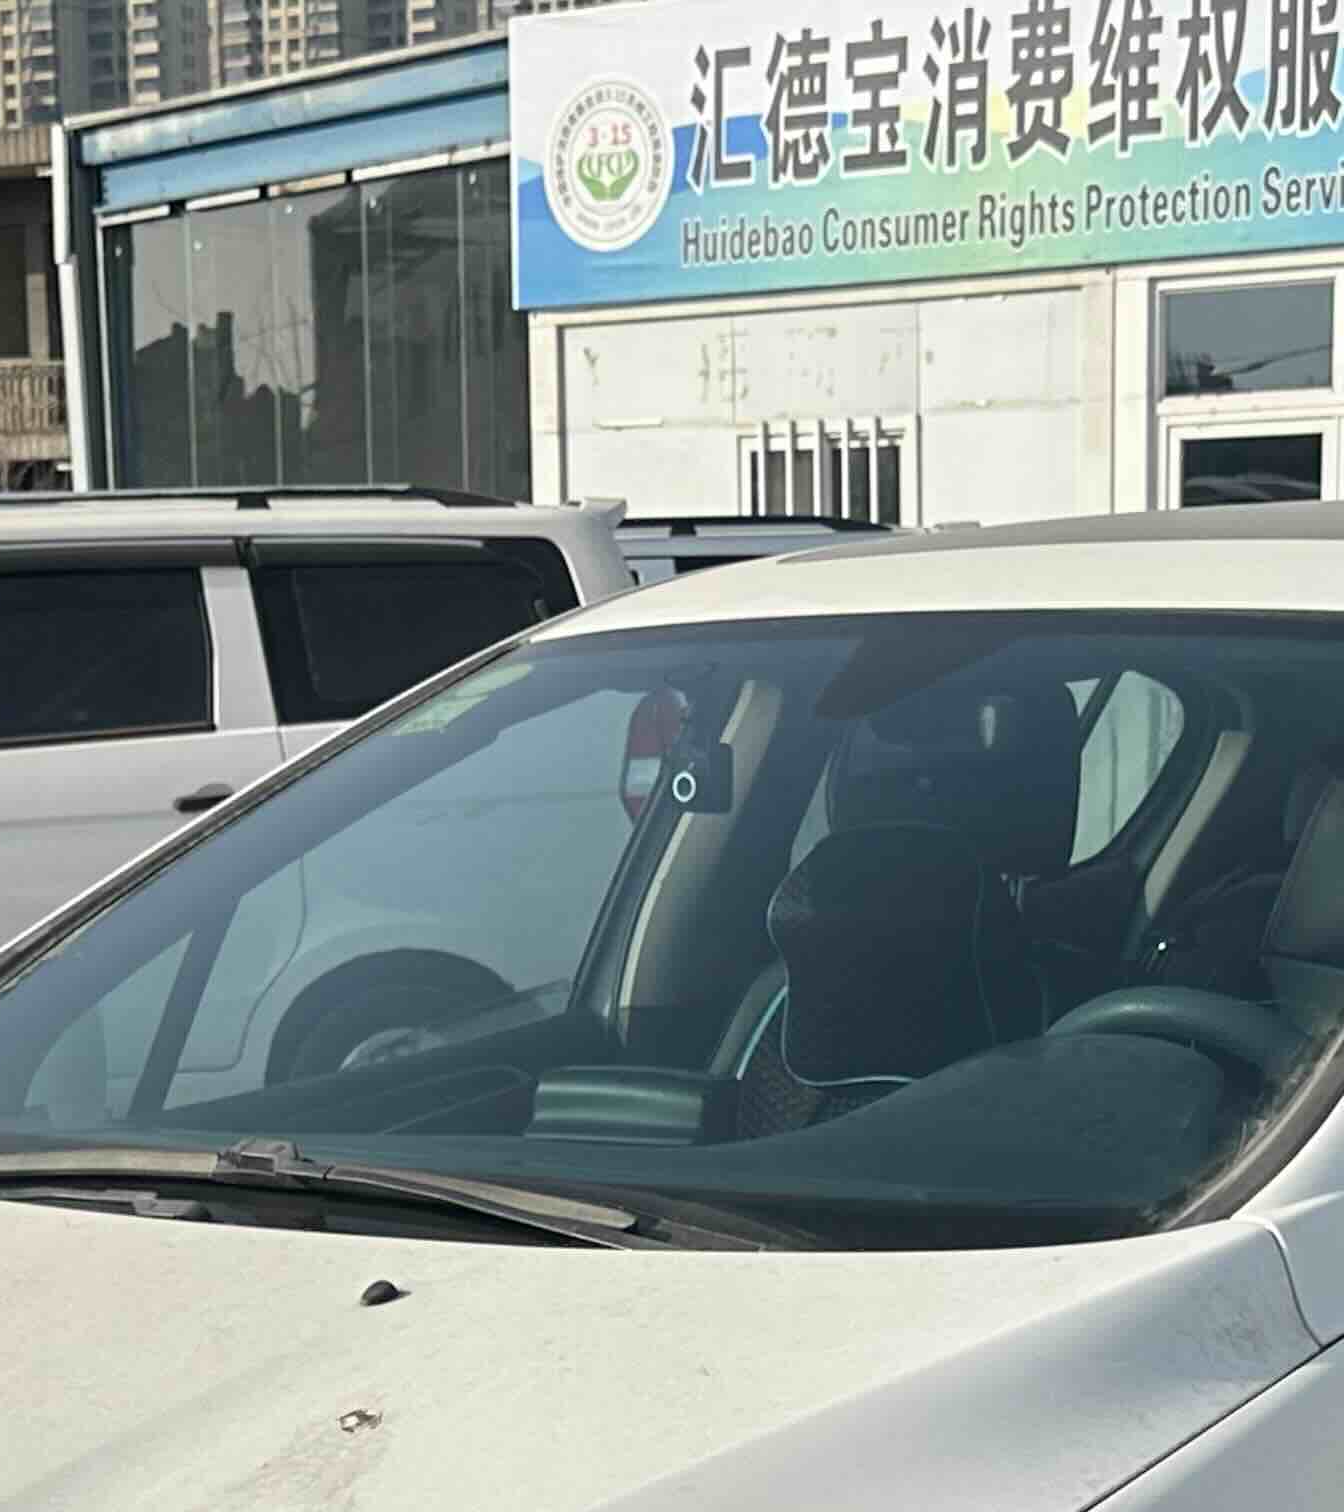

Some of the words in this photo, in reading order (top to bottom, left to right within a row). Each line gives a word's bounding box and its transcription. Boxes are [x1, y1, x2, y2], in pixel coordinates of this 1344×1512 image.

[682, 220, 814, 264] Huidebao
[822, 205, 970, 253] Consumer
[977, 192, 1076, 250] Rights
[1085, 173, 1252, 232] Protection
